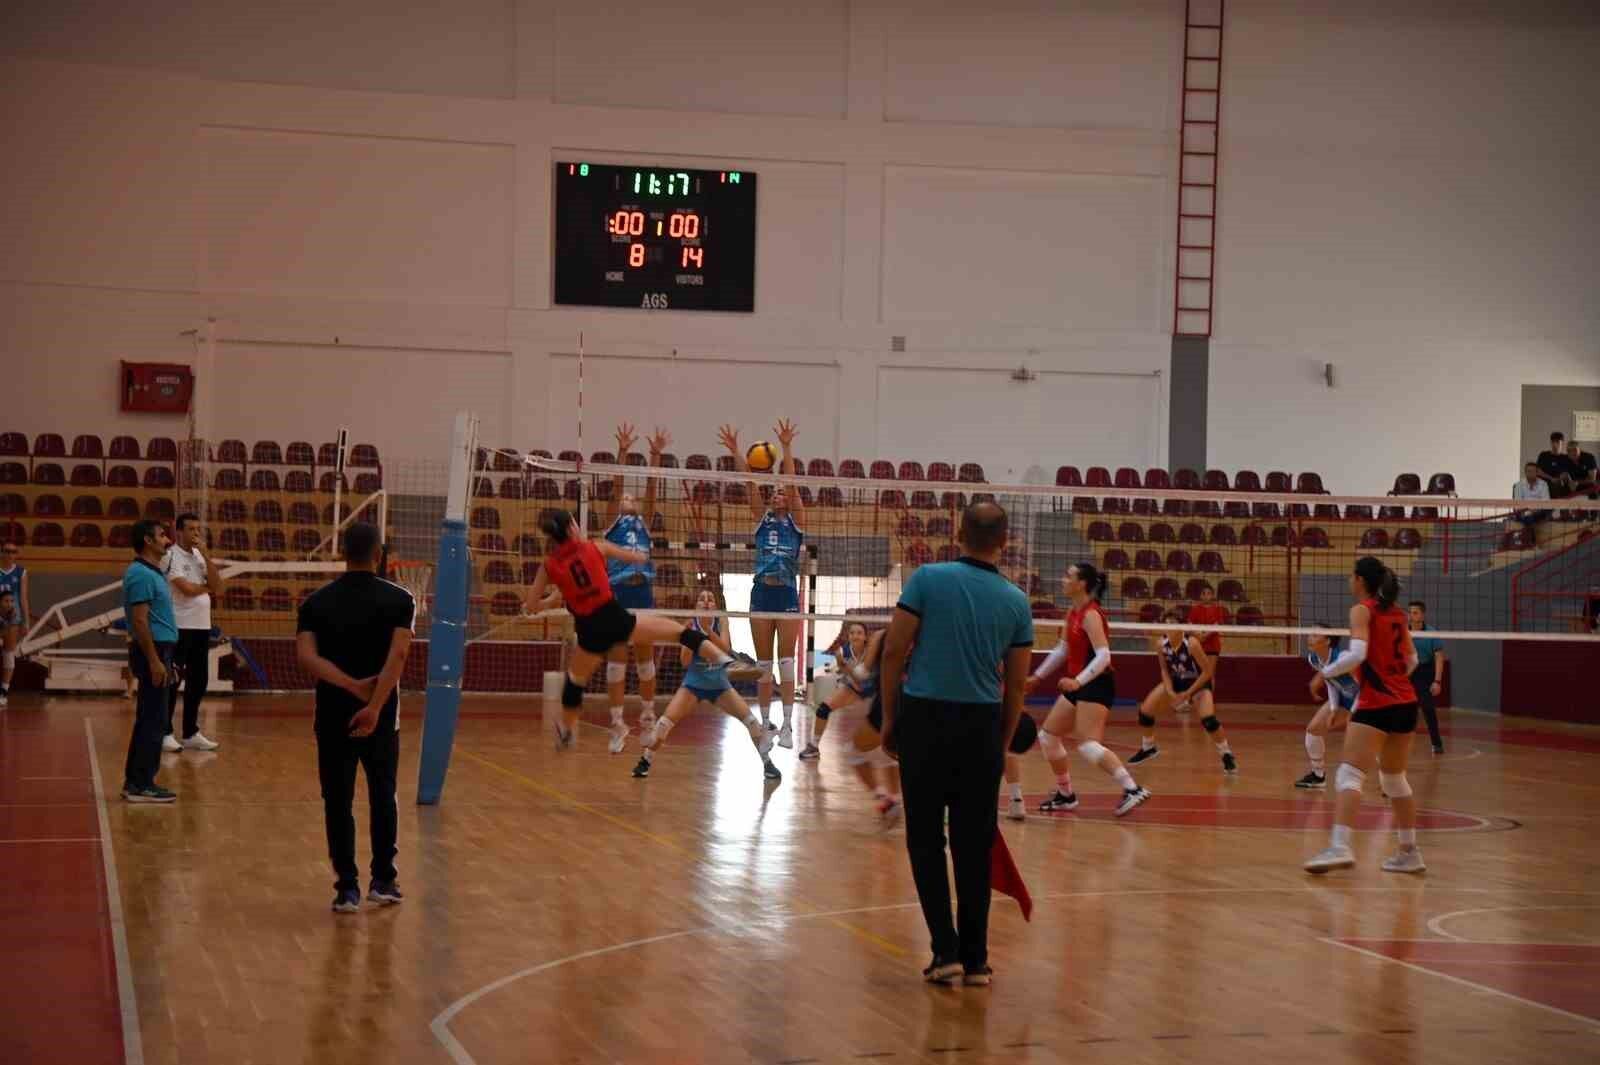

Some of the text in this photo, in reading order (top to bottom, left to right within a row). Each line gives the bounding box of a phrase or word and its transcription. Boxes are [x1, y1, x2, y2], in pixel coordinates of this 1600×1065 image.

[669, 214, 699, 238] 00
[629, 243, 645, 267] 8
[682, 247, 704, 268] 14
[641, 292, 669, 309] AGS
